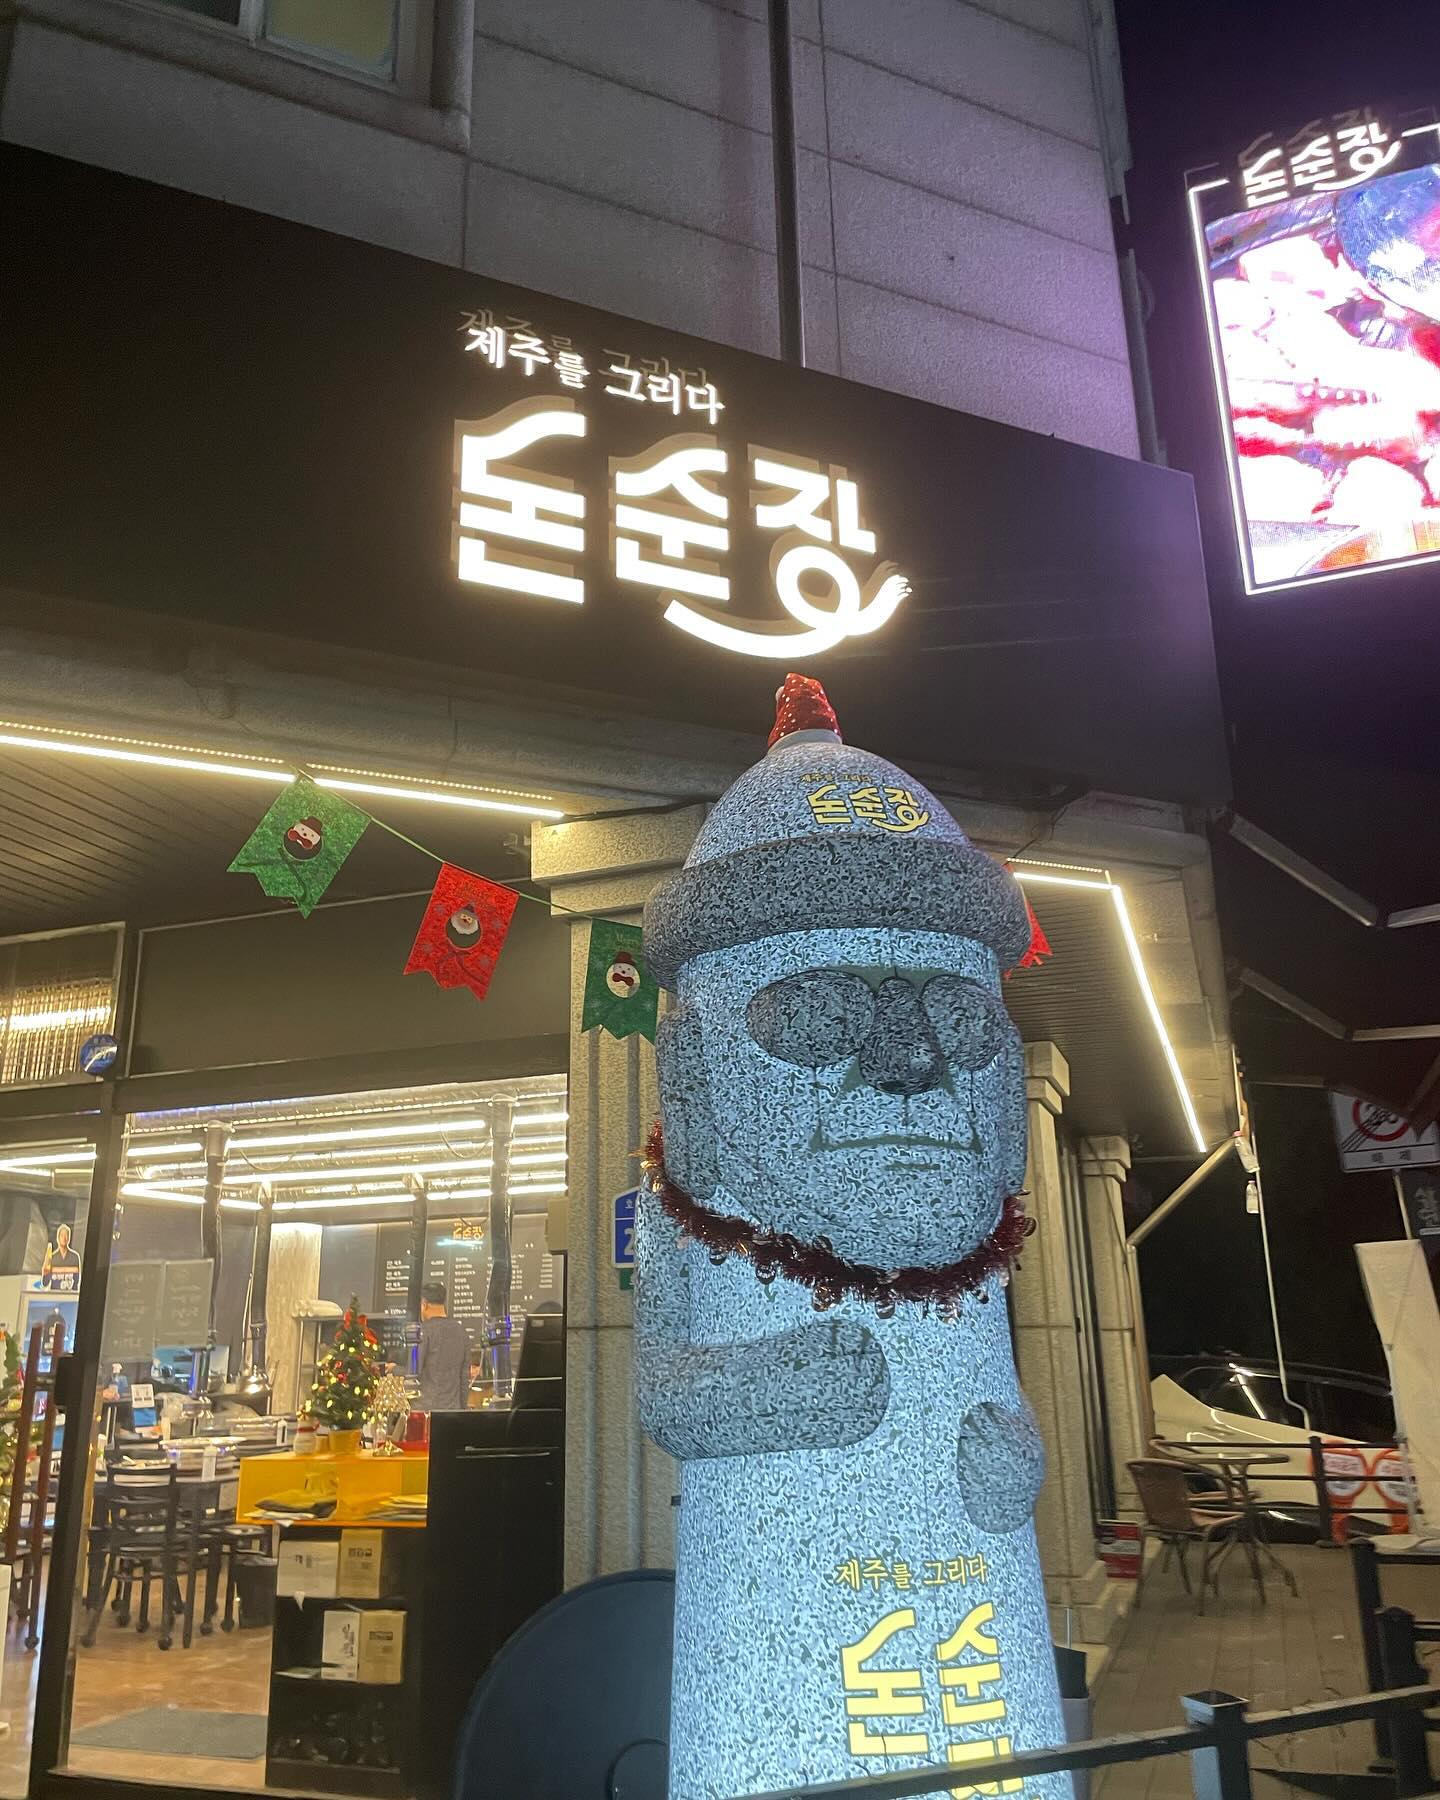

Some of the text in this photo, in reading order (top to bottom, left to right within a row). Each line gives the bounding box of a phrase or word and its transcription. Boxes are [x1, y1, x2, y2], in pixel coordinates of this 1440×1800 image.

[465, 325, 725, 424] 제주를 그리다
[836, 1553, 988, 1591] 제주를 그리다
